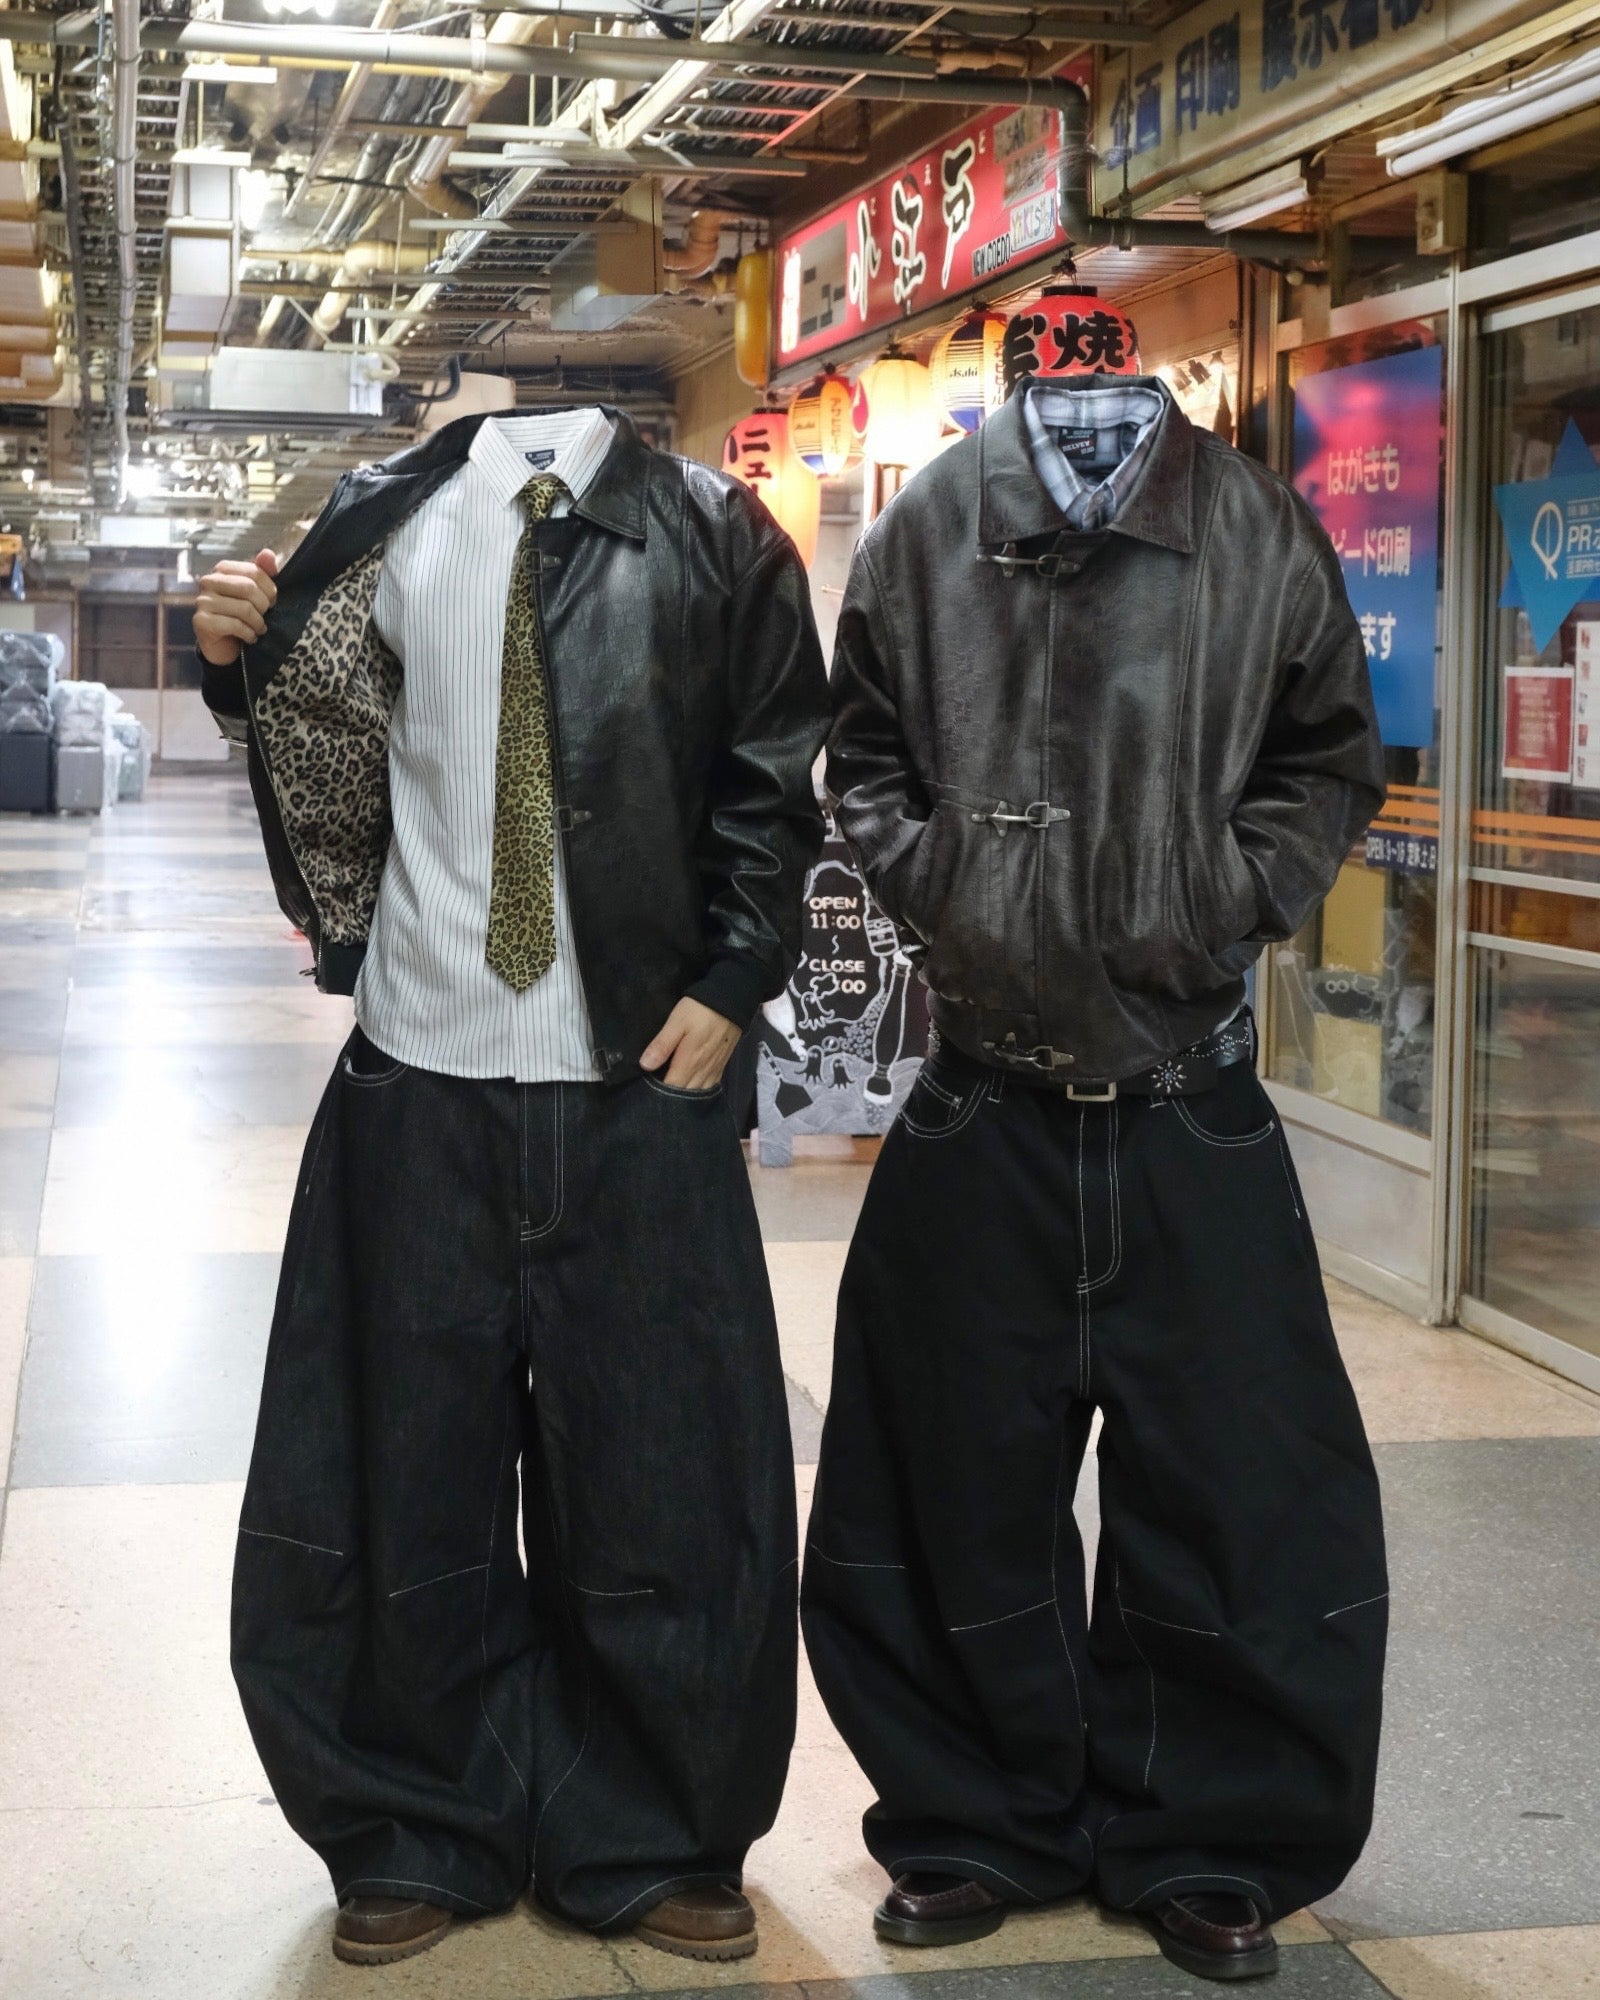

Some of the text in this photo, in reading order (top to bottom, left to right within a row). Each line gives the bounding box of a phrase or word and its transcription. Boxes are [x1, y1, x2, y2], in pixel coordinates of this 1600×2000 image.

[1175, 12, 1240, 137] 印刷
[1259, 0, 1424, 93] 展示看
[1327, 443, 1400, 496] はがきも
[809, 896, 858, 911] OPEN
[810, 912, 861, 930] 11:00
[809, 958, 866, 973] CLOSE
